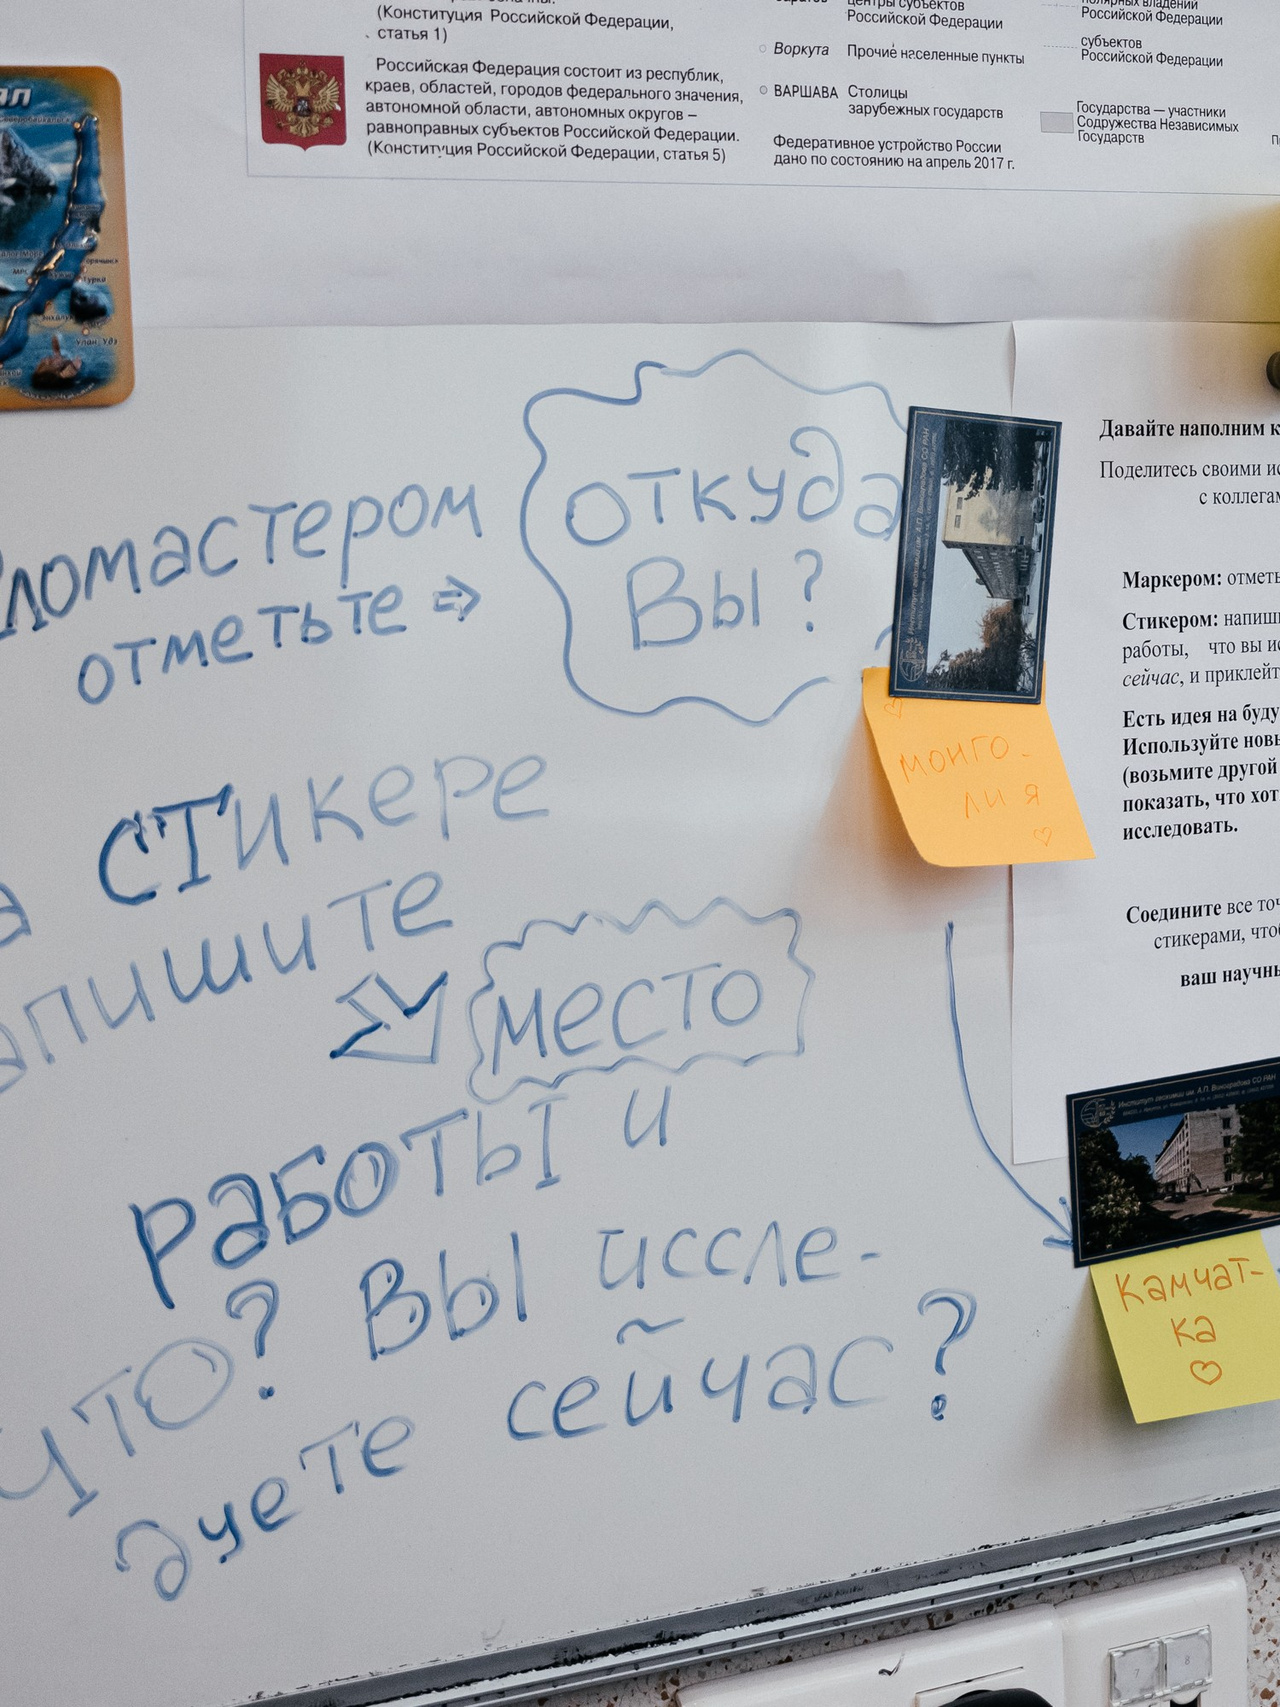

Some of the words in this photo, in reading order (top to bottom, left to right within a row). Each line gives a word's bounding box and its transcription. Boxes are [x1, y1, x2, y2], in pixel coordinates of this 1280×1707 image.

[847, 8, 926, 26] Российской
[928, 12, 1003, 31] Федерации
[773, 41, 830, 59] Воркута
[847, 44, 898, 60] Прочие
[981, 52, 1025, 66] пункты
[376, 57, 469, 74] Российская
[471, 59, 560, 79] Федерация
[563, 66, 623, 79] состоит
[625, 68, 643, 80] из
[645, 67, 724, 85] республик,
[365, 80, 415, 95] краев,
[419, 78, 497, 97] областей,
[500, 84, 563, 99] городов
[566, 83, 672, 102] федерального
[674, 90, 744, 105] значения,
[774, 83, 839, 100] ВАРШАВА
[847, 84, 908, 103] Столицы
[365, 100, 461, 115] автономной
[464, 100, 531, 119] области,
[535, 105, 626, 119] автономных
[628, 108, 684, 123] округов
[848, 101, 931, 118] зарубежных
[933, 106, 1004, 121] государств
[366, 122, 479, 138] равноправных
[482, 121, 560, 139] субъектов
[563, 123, 651, 140] Российской
[653, 125, 740, 144] Федерации.
[476, 142, 567, 158] Российской
[570, 143, 660, 162] Федерации,
[663, 149, 709, 161] статья
[712, 147, 726, 165] 5)
[773, 133, 875, 152] Федеративное
[877, 138, 953, 154] устройство
[955, 139, 1002, 155] России
[773, 154, 808, 167] дано
[810, 154, 828, 166] по
[830, 155, 905, 168] состоянию
[907, 157, 923, 168] на
[925, 157, 972, 171] апрель
[973, 156, 1005, 170] 2017
[1007, 159, 1015, 170] г.
[1098, 418, 1175, 441] Давайте
[1179, 423, 1265, 437] наполним
[1099, 460, 1198, 481] Поделитесь
[1202, 463, 1262, 477] своими
[1199, 491, 1208, 506] с
[0, 483, 483, 641] ломастером
[1122, 570, 1222, 592] Маркером:
[1122, 612, 1218, 632] Стикером:
[1122, 639, 1189, 663] работы,
[1208, 641, 1236, 655] что
[1240, 640, 1263, 654] вы
[1122, 667, 1185, 688] сейчас,
[1189, 670, 1200, 684] и
[1122, 710, 1166, 728] Есть
[1171, 710, 1212, 727] идея
[1217, 709, 1238, 723] на
[1122, 732, 1239, 756] Используйте
[1122, 765, 1214, 789] (возьмите
[1217, 756, 1278, 783] другой
[1123, 794, 1210, 813] показать,
[1215, 791, 1246, 806] что
[1122, 820, 1238, 841] исследовать.
[1126, 903, 1222, 924] Соедините
[1226, 900, 1253, 915] все
[1153, 928, 1246, 950] стикерами,
[1180, 971, 1217, 988] ваш
